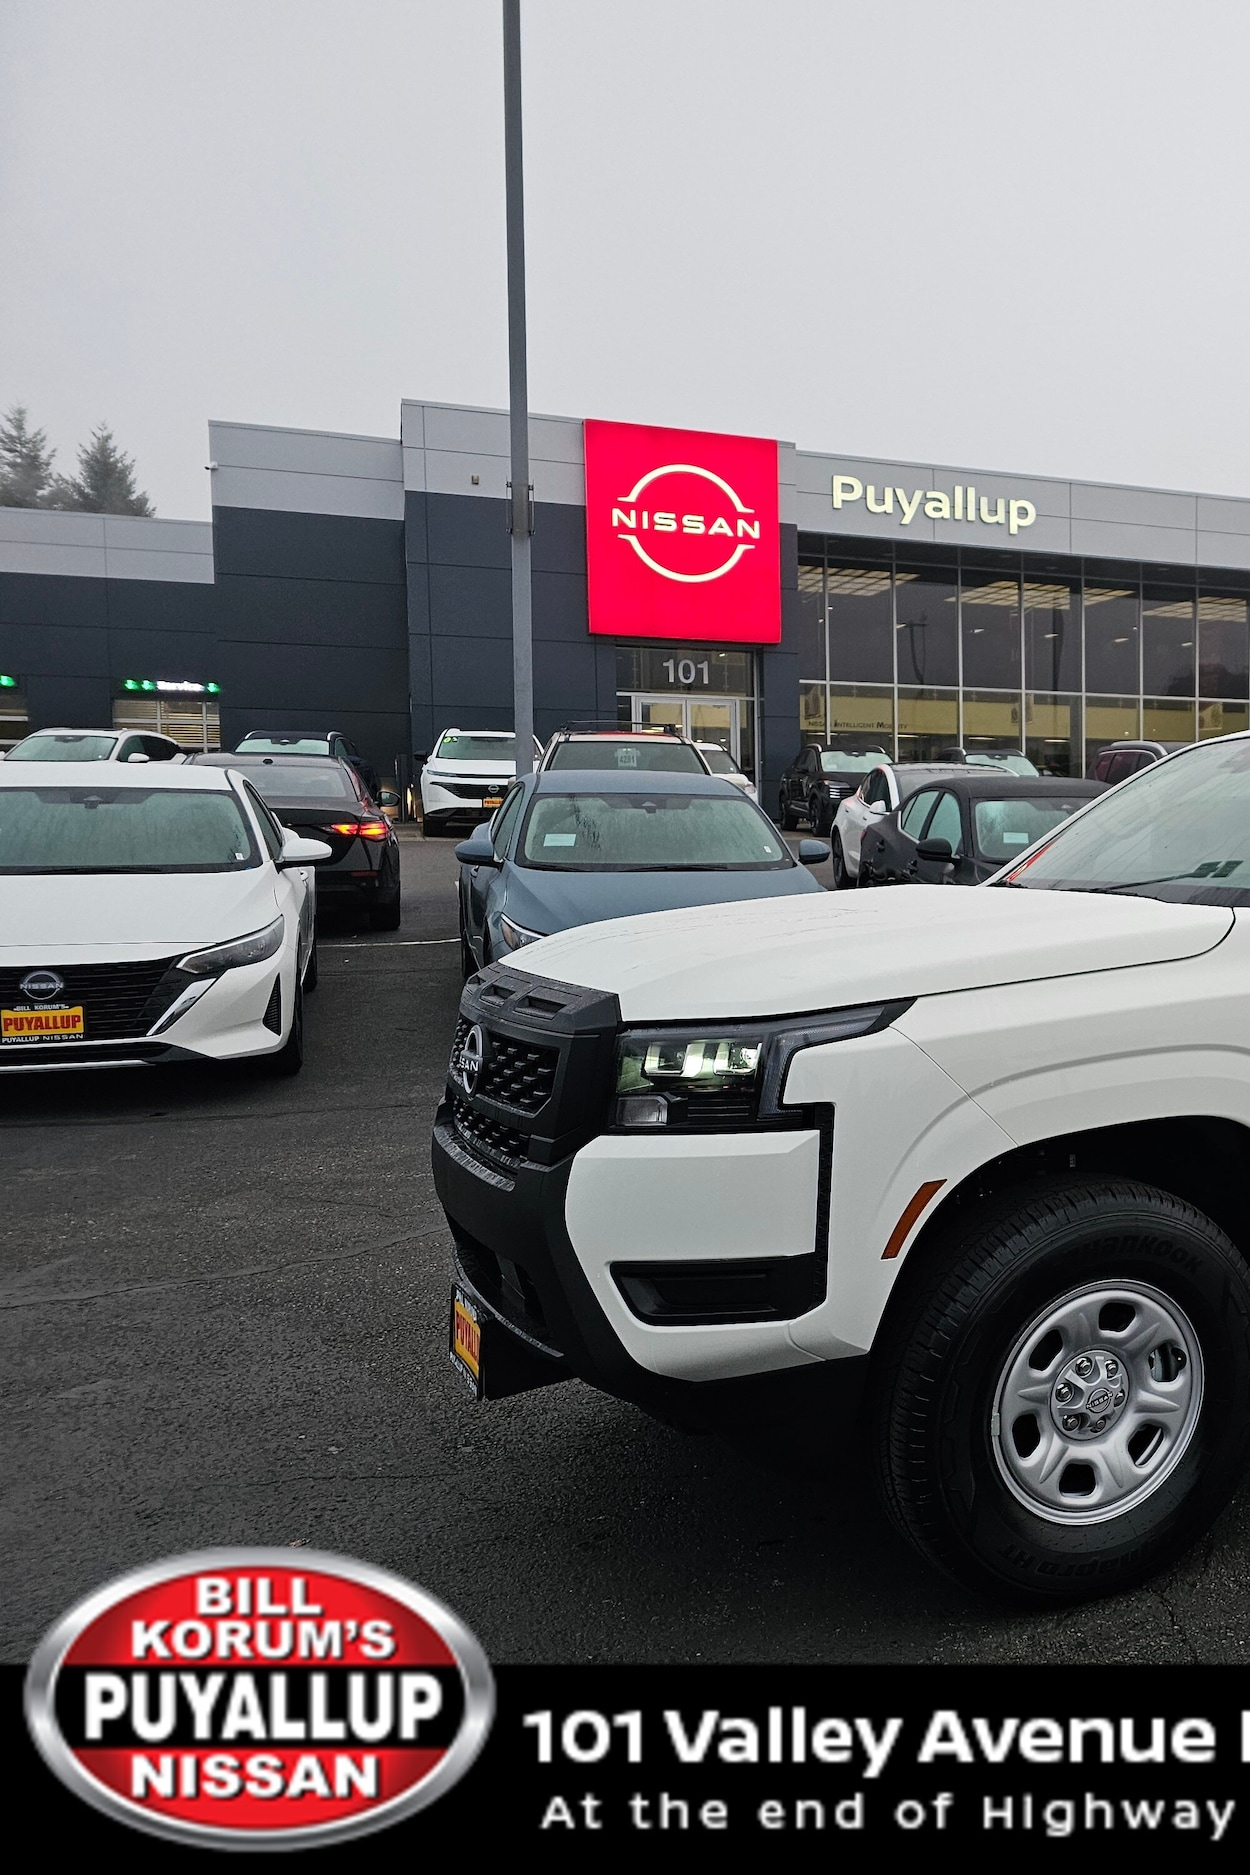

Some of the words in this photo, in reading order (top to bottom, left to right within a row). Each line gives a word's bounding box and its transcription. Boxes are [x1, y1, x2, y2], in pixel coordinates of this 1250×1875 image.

[832, 475, 1036, 535] Puyallup
[611, 507, 761, 540] NISSAN
[663, 658, 709, 685] 101
[34, 1003, 66, 1011] KORUM'S
[3, 1014, 81, 1032] PUYALLUP
[2, 1035, 40, 1043] PUYALLUP
[42, 1033, 84, 1041] NISSAN
[1086, 1391, 1113, 1409] NISSAN
